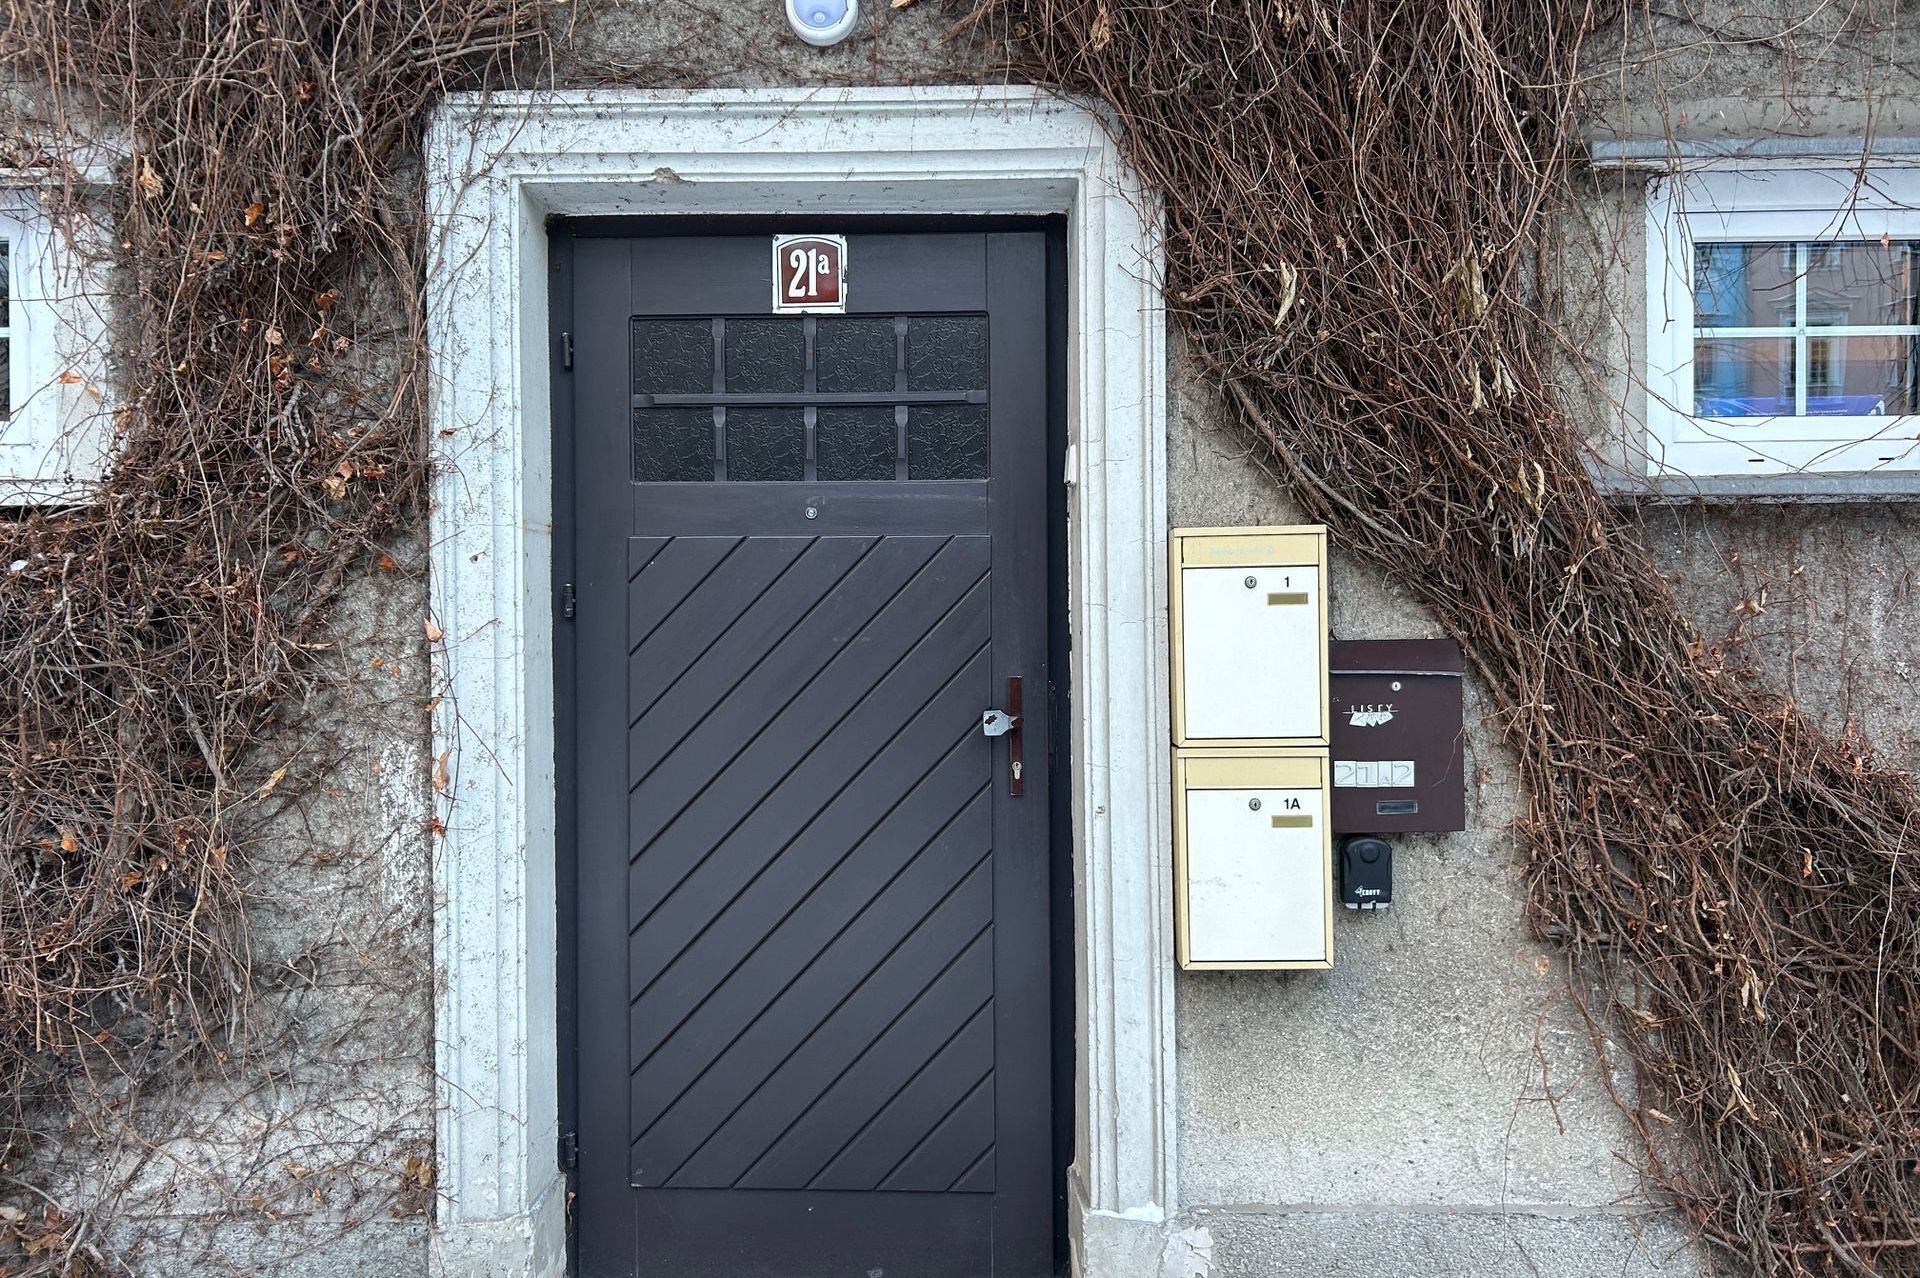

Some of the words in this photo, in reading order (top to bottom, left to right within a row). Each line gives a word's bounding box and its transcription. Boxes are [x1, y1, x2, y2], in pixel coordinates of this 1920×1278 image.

[788, 248, 830, 298] 21a
[1284, 576, 1290, 588] 1
[1284, 798, 1301, 810] 1A
